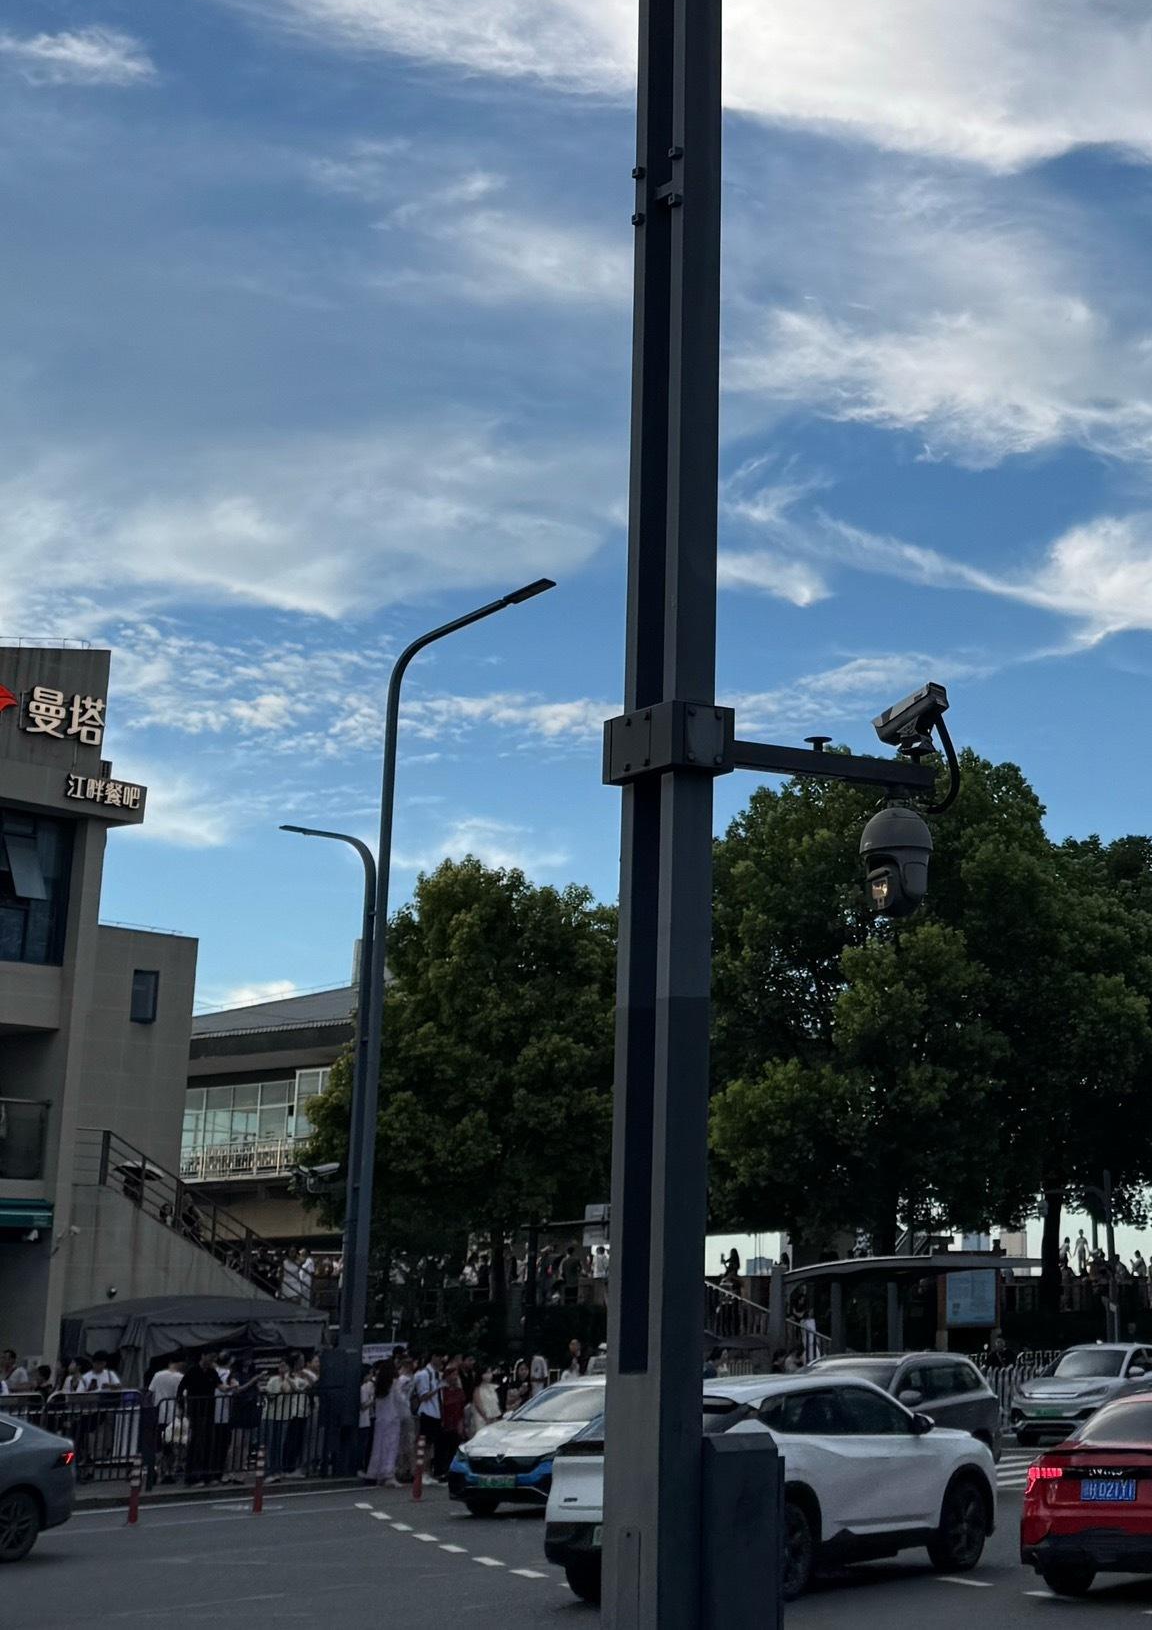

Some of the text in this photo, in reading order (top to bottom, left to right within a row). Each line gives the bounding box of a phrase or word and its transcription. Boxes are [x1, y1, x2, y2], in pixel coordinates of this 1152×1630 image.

[26, 686, 106, 746] 曼塔
[67, 773, 141, 810] 江畔餐吧
